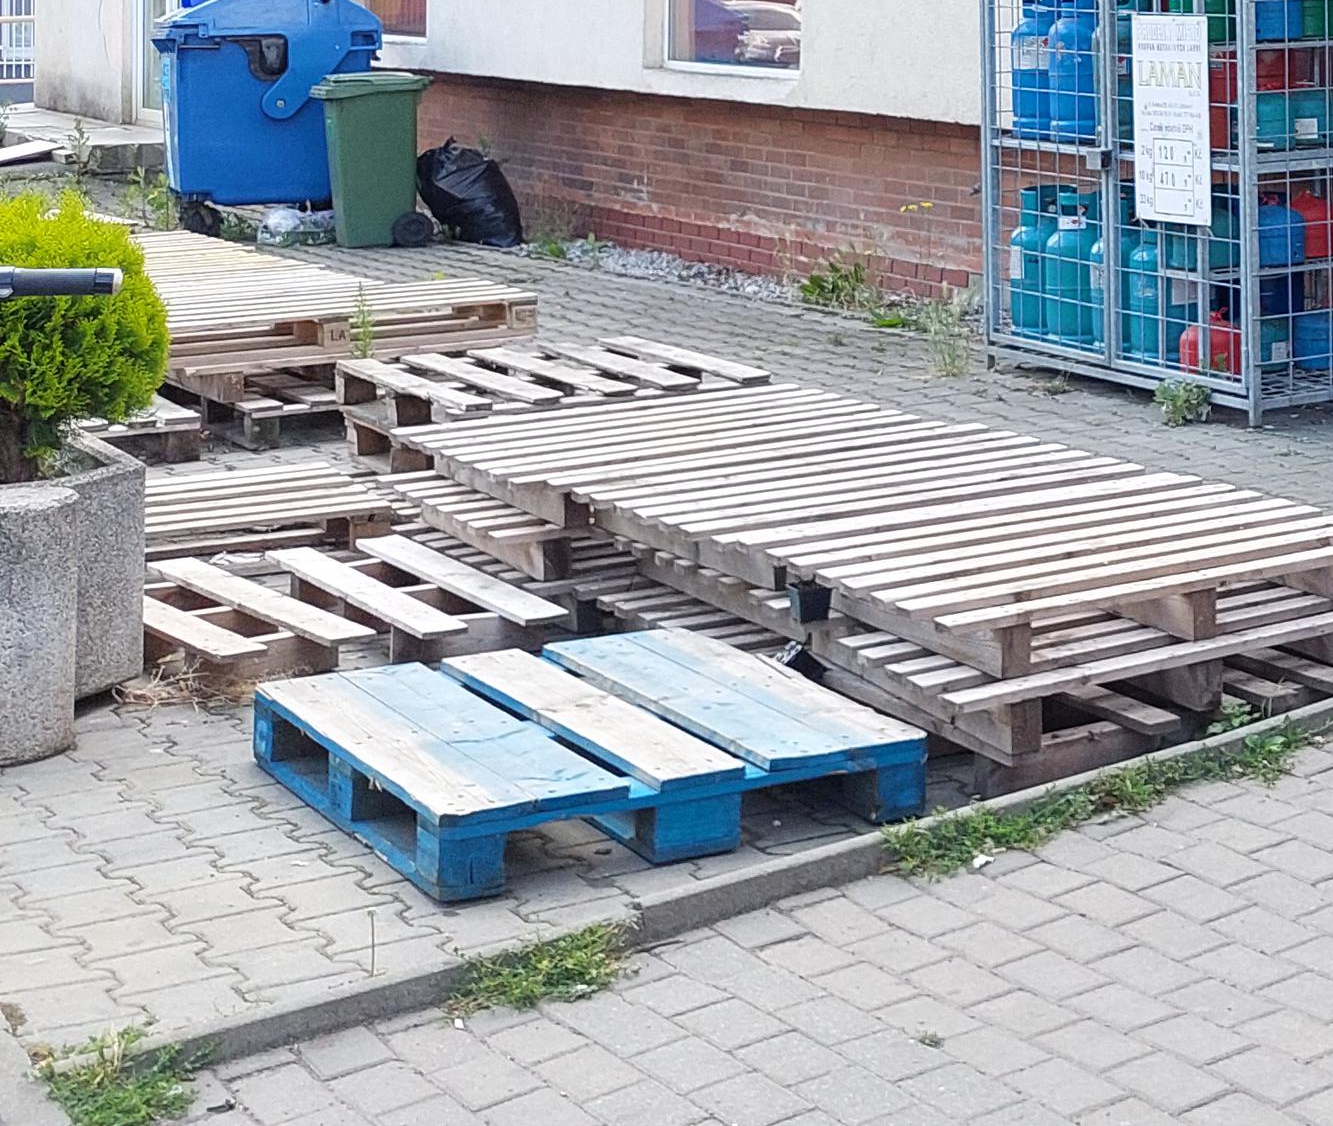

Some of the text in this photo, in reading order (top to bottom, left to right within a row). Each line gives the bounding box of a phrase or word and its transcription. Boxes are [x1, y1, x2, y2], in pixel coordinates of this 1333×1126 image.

[1137, 60, 1202, 90] LAMAN
[1158, 145, 1175, 161] 120
[1160, 171, 1176, 187] 470
[330, 329, 346, 342] LA
